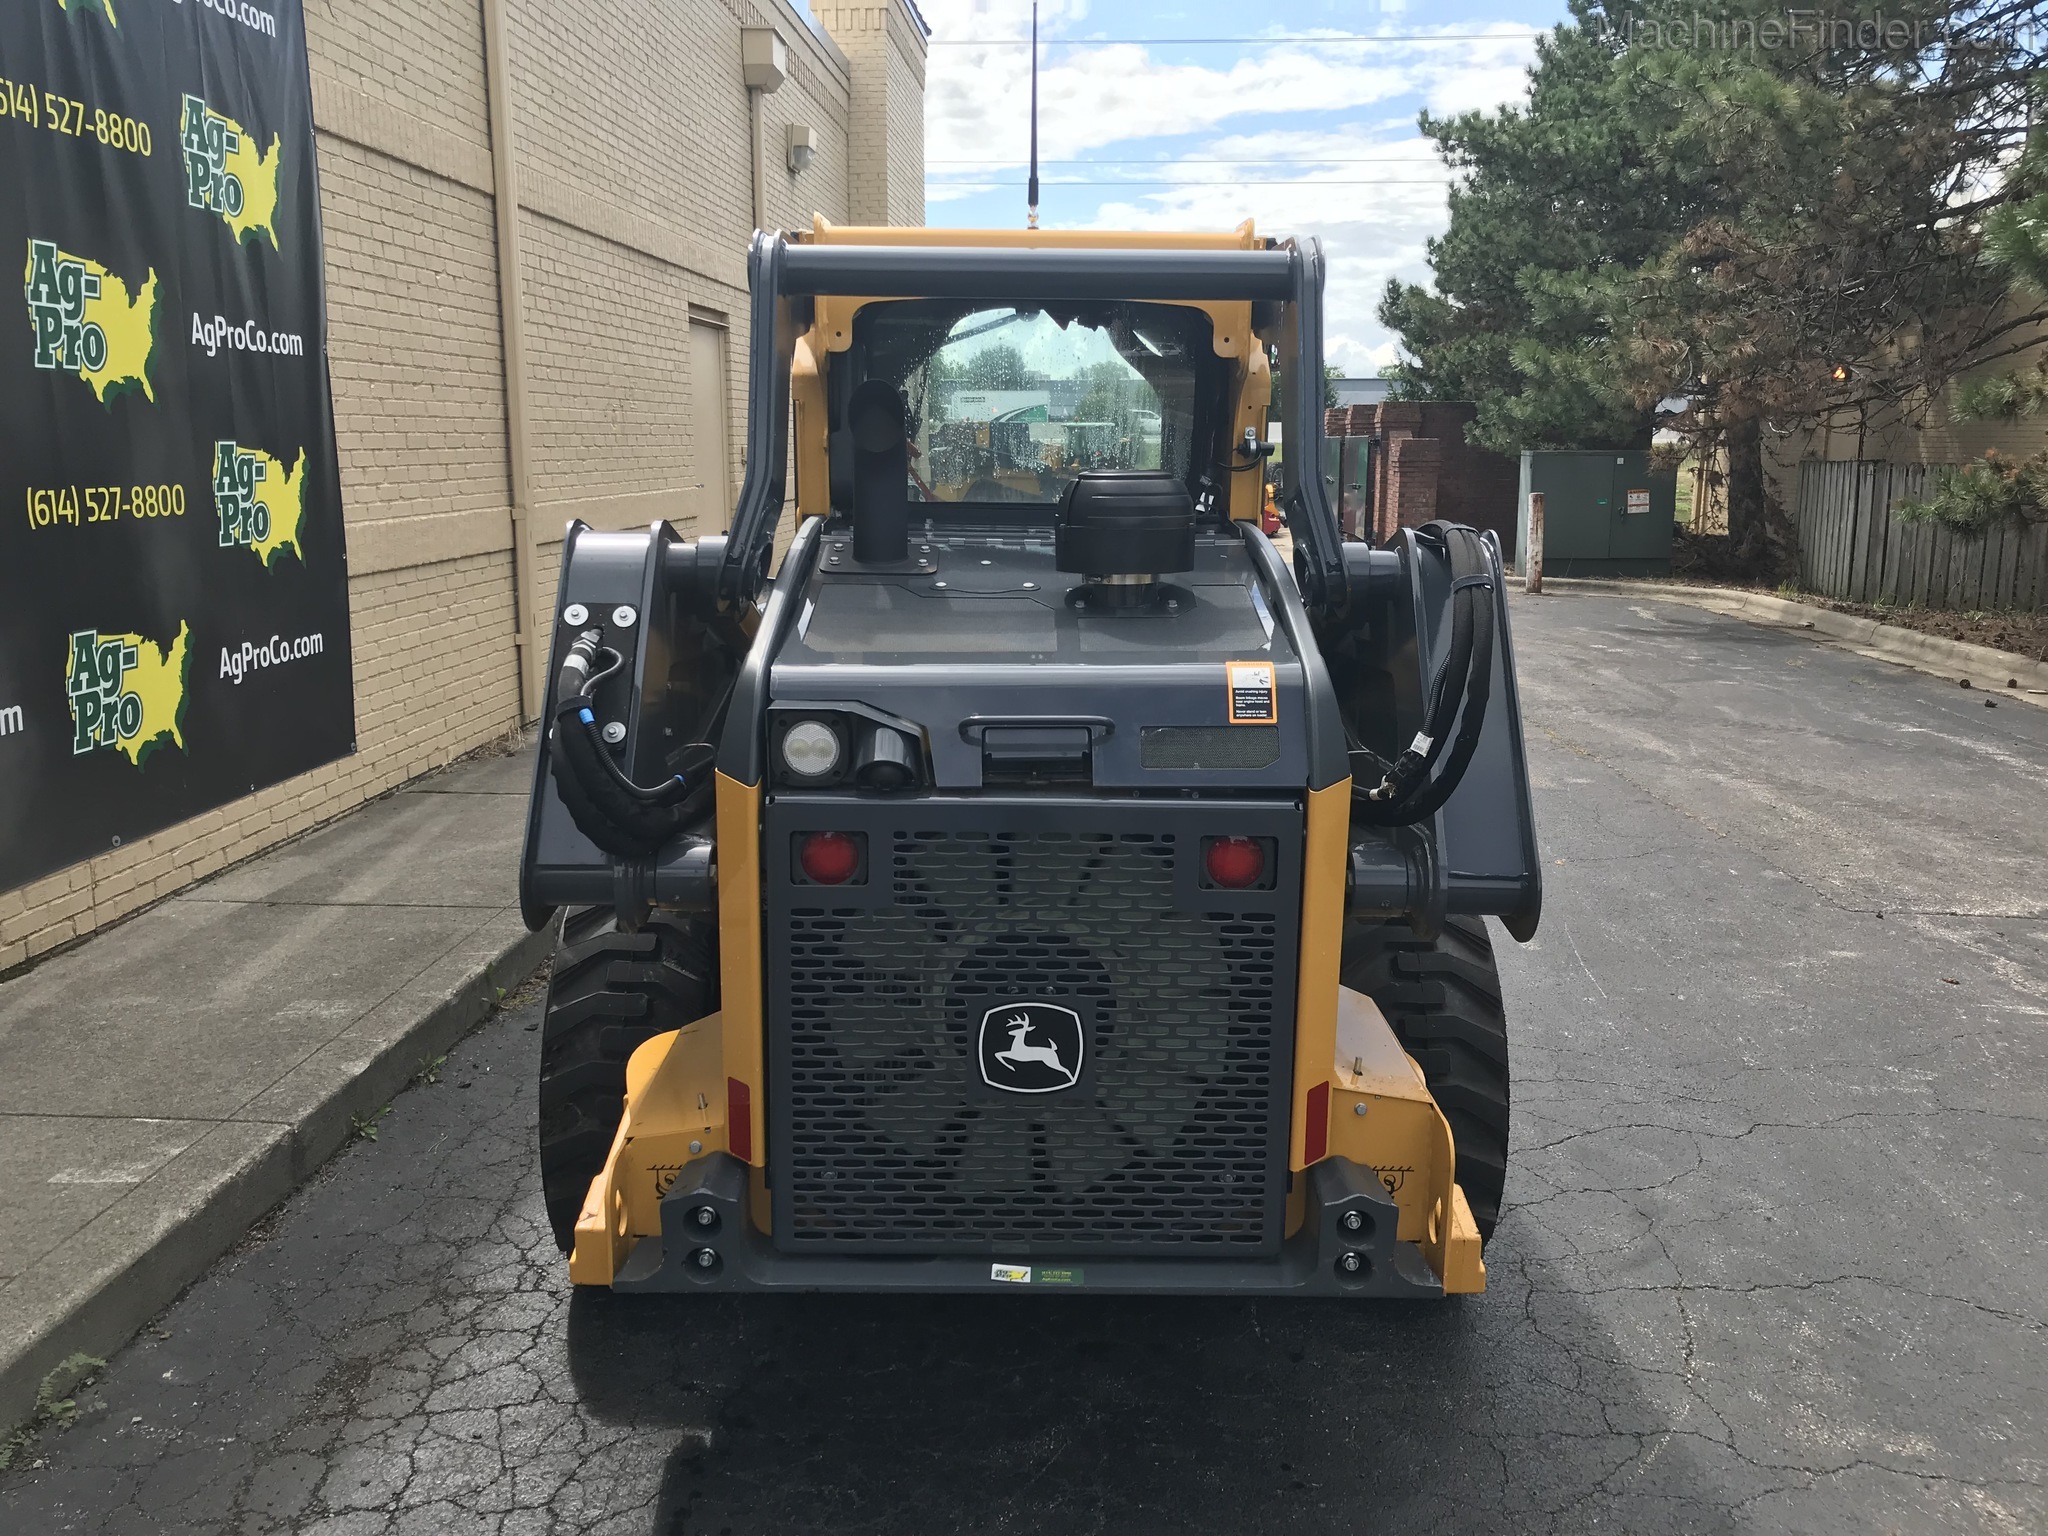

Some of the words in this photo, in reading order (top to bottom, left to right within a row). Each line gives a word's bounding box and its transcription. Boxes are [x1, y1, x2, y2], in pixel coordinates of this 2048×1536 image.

[45, 92, 151, 156] 527-8800
[183, 94, 239, 171] Ag-
[188, 153, 243, 216] Pro
[28, 239, 101, 321] Ag-
[33, 303, 107, 371] Pro
[191, 312, 303, 357] AgProCo.com
[215, 441, 266, 503] Ag-
[27, 485, 79, 530] (614)
[86, 484, 185, 523] 527-8800
[218, 494, 270, 547] Pro
[69, 630, 137, 698] Ag-
[219, 631, 323, 685] AgProCo.com
[72, 690, 142, 755] Pro
